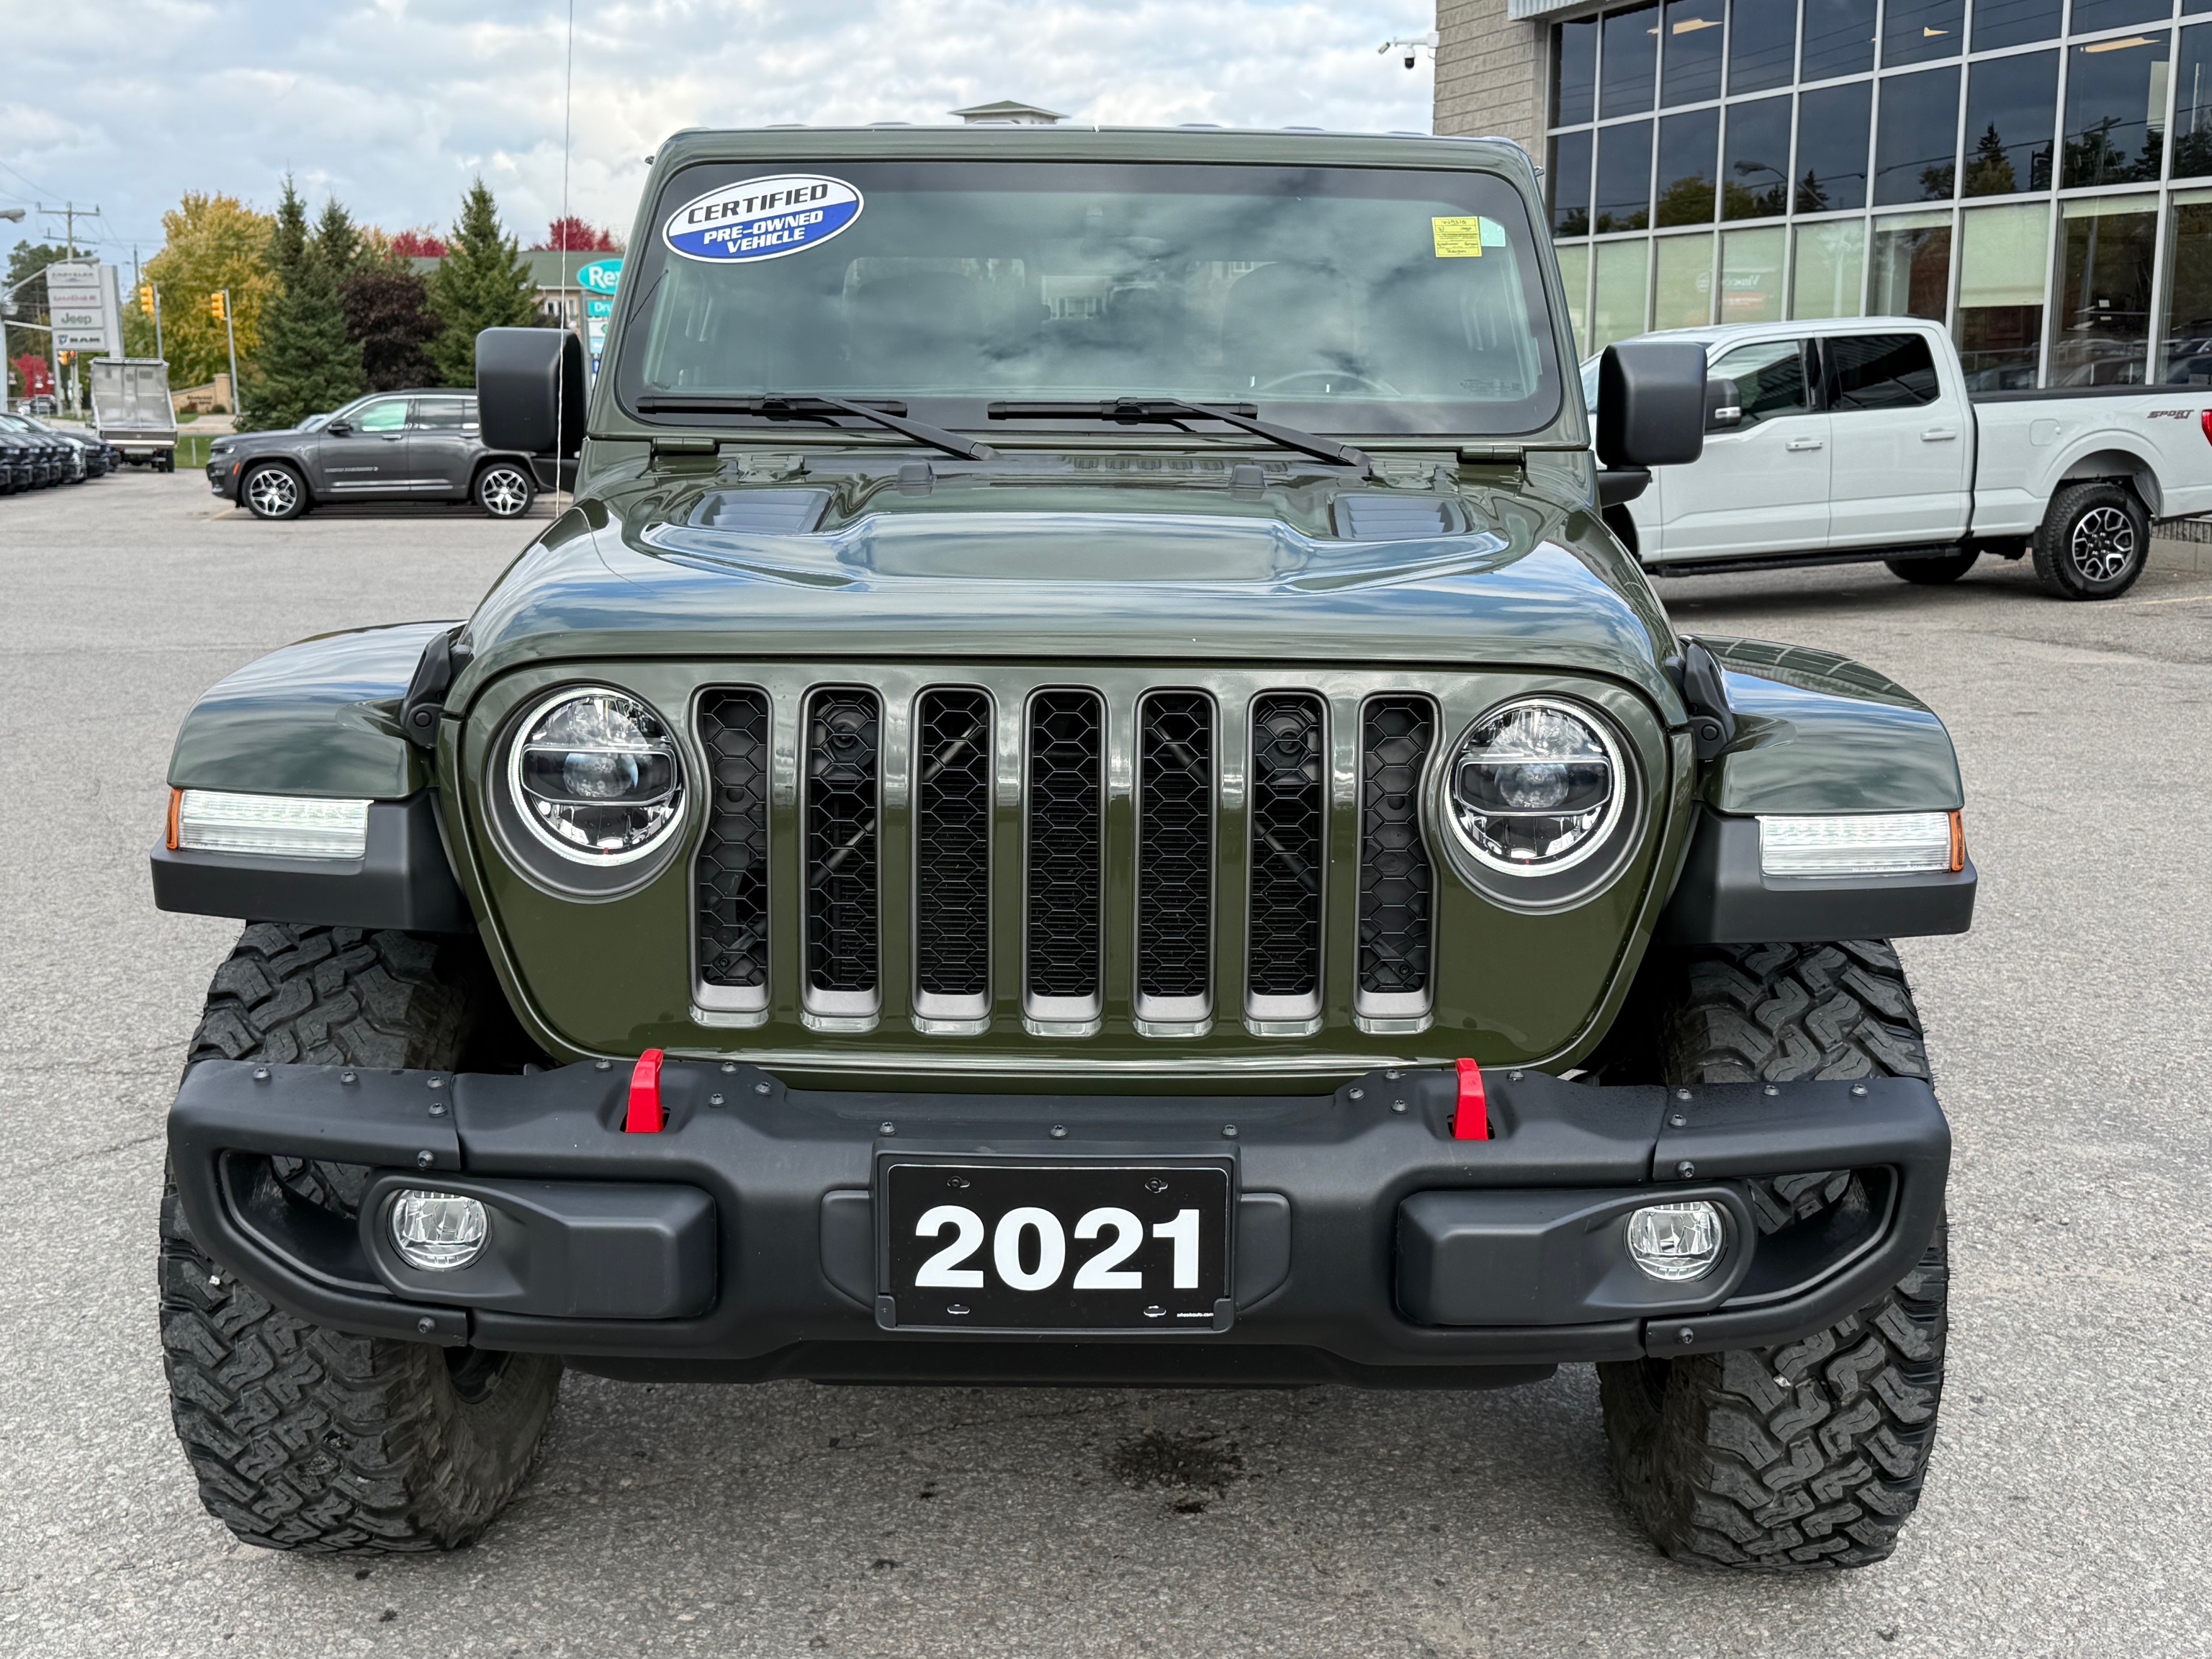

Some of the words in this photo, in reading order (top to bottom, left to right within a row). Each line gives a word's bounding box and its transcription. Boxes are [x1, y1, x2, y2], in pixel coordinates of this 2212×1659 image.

[688, 183, 828, 225] CERTIFIED
[703, 210, 824, 245] PRE-OWNED
[727, 227, 805, 253] VEHICLE
[60, 313, 92, 325] Jeep
[2147, 409, 2195, 419] SPORT
[915, 1205, 1199, 1290] 2021
